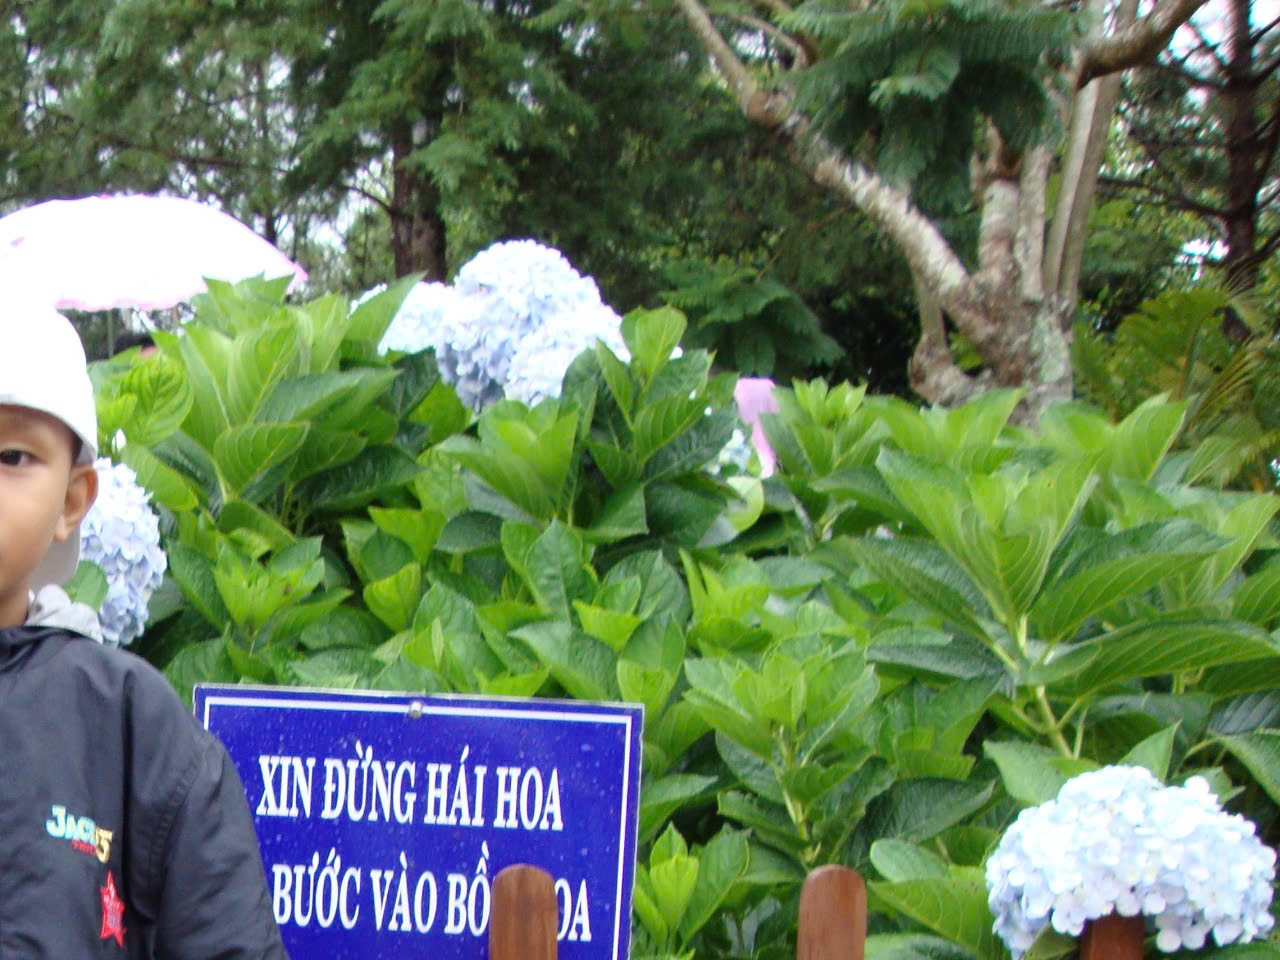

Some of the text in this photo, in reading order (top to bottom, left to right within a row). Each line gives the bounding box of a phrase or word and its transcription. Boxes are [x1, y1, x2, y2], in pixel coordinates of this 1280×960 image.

[255, 740, 564, 831] XIN ĐỪNG HÁI HOA
[271, 840, 592, 942] BƯỚC VÀO BỒ OA
